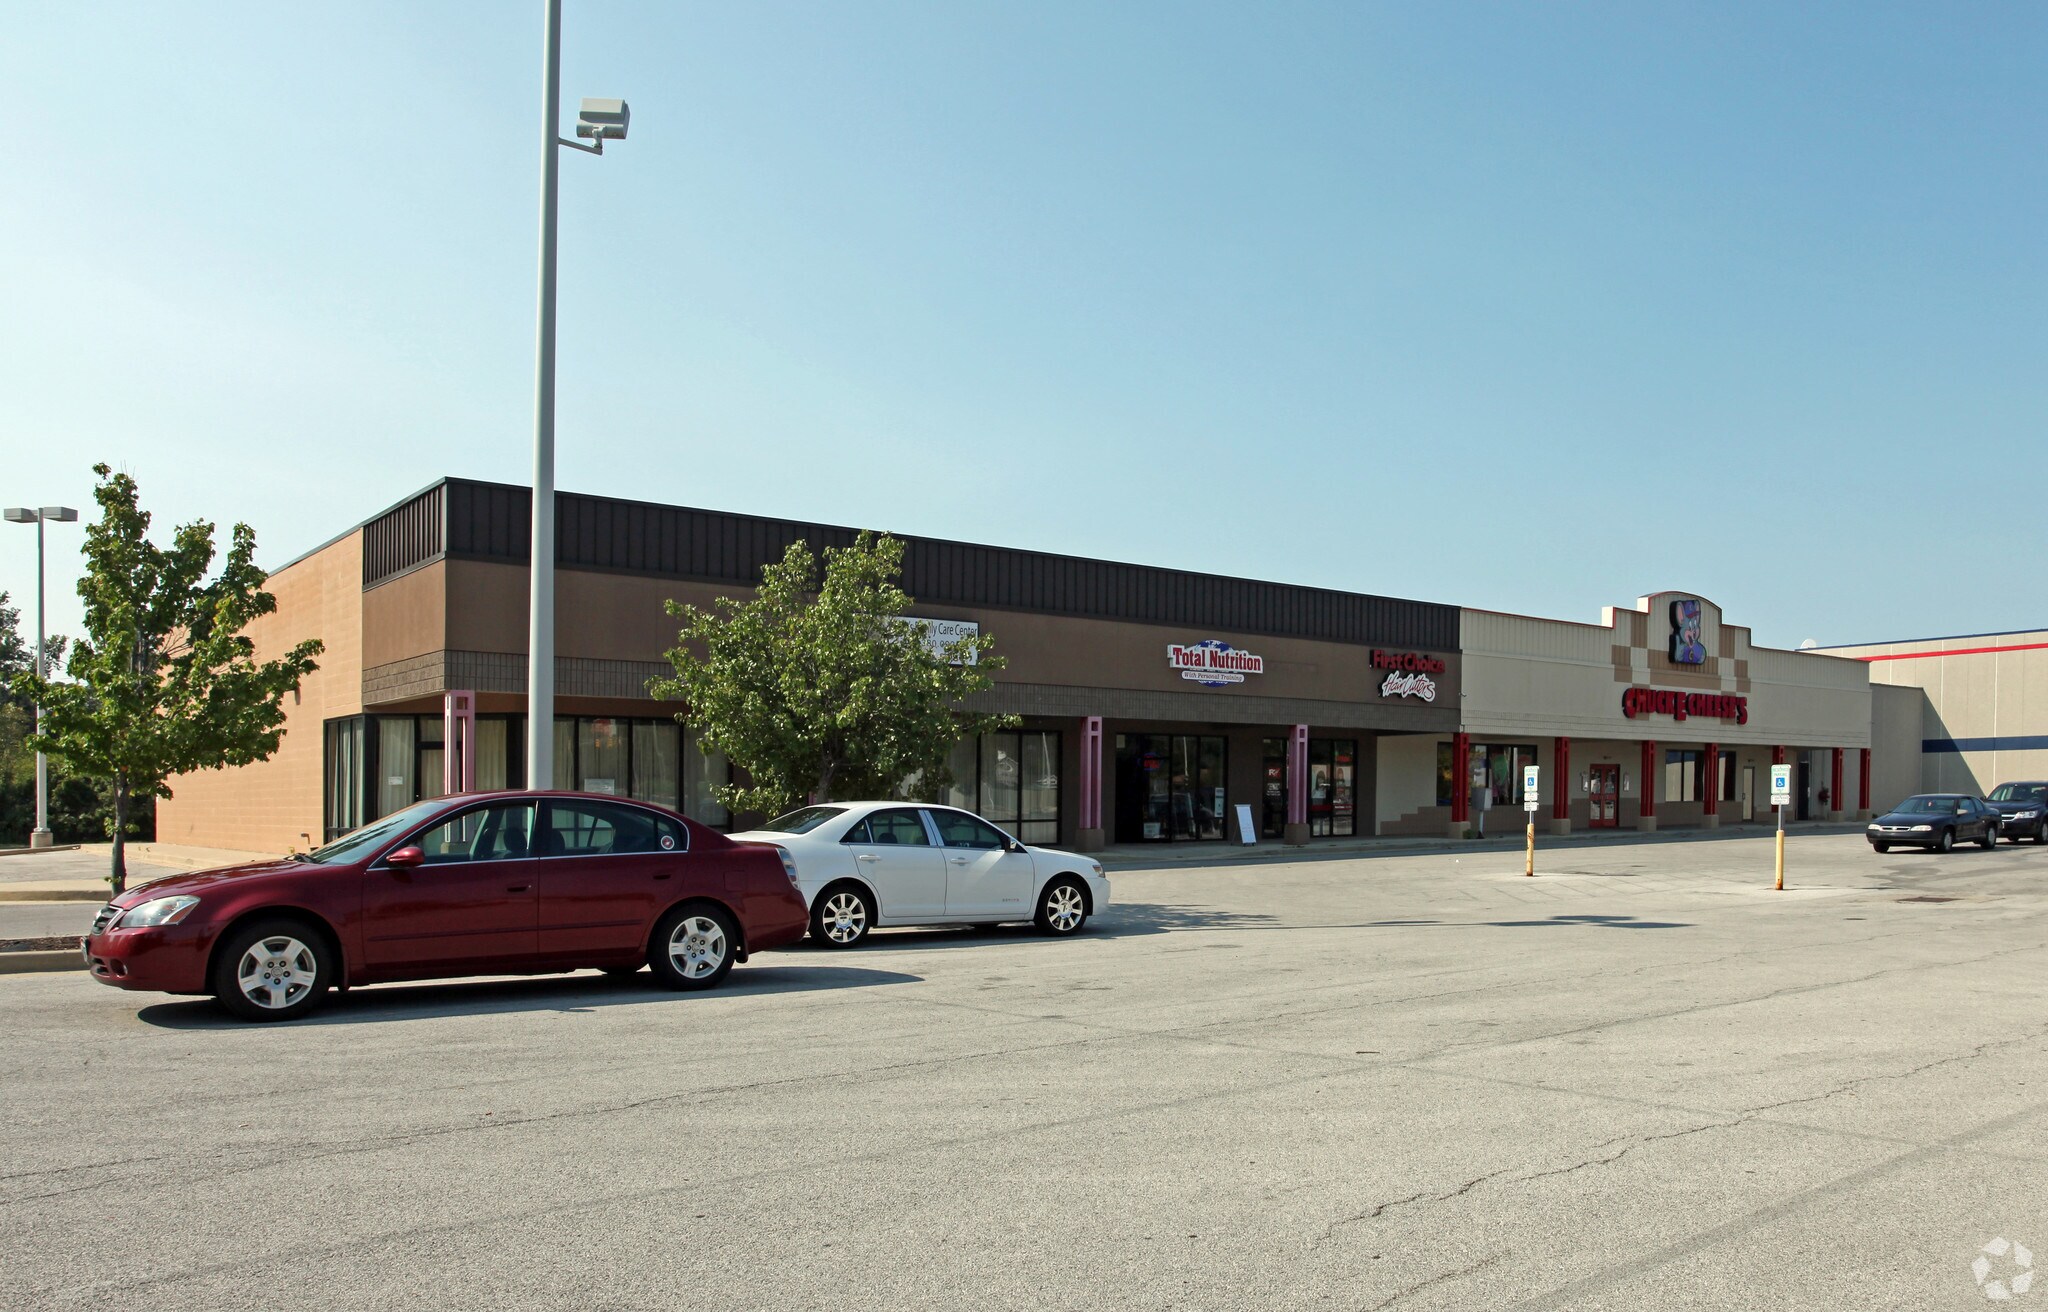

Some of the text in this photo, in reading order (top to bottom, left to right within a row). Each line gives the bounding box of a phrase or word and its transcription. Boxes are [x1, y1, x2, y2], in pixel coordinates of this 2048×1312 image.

[938, 623, 953, 635] Care
[1172, 647, 1261, 671] Total Nutrition
[1373, 649, 1445, 673] First Choice
